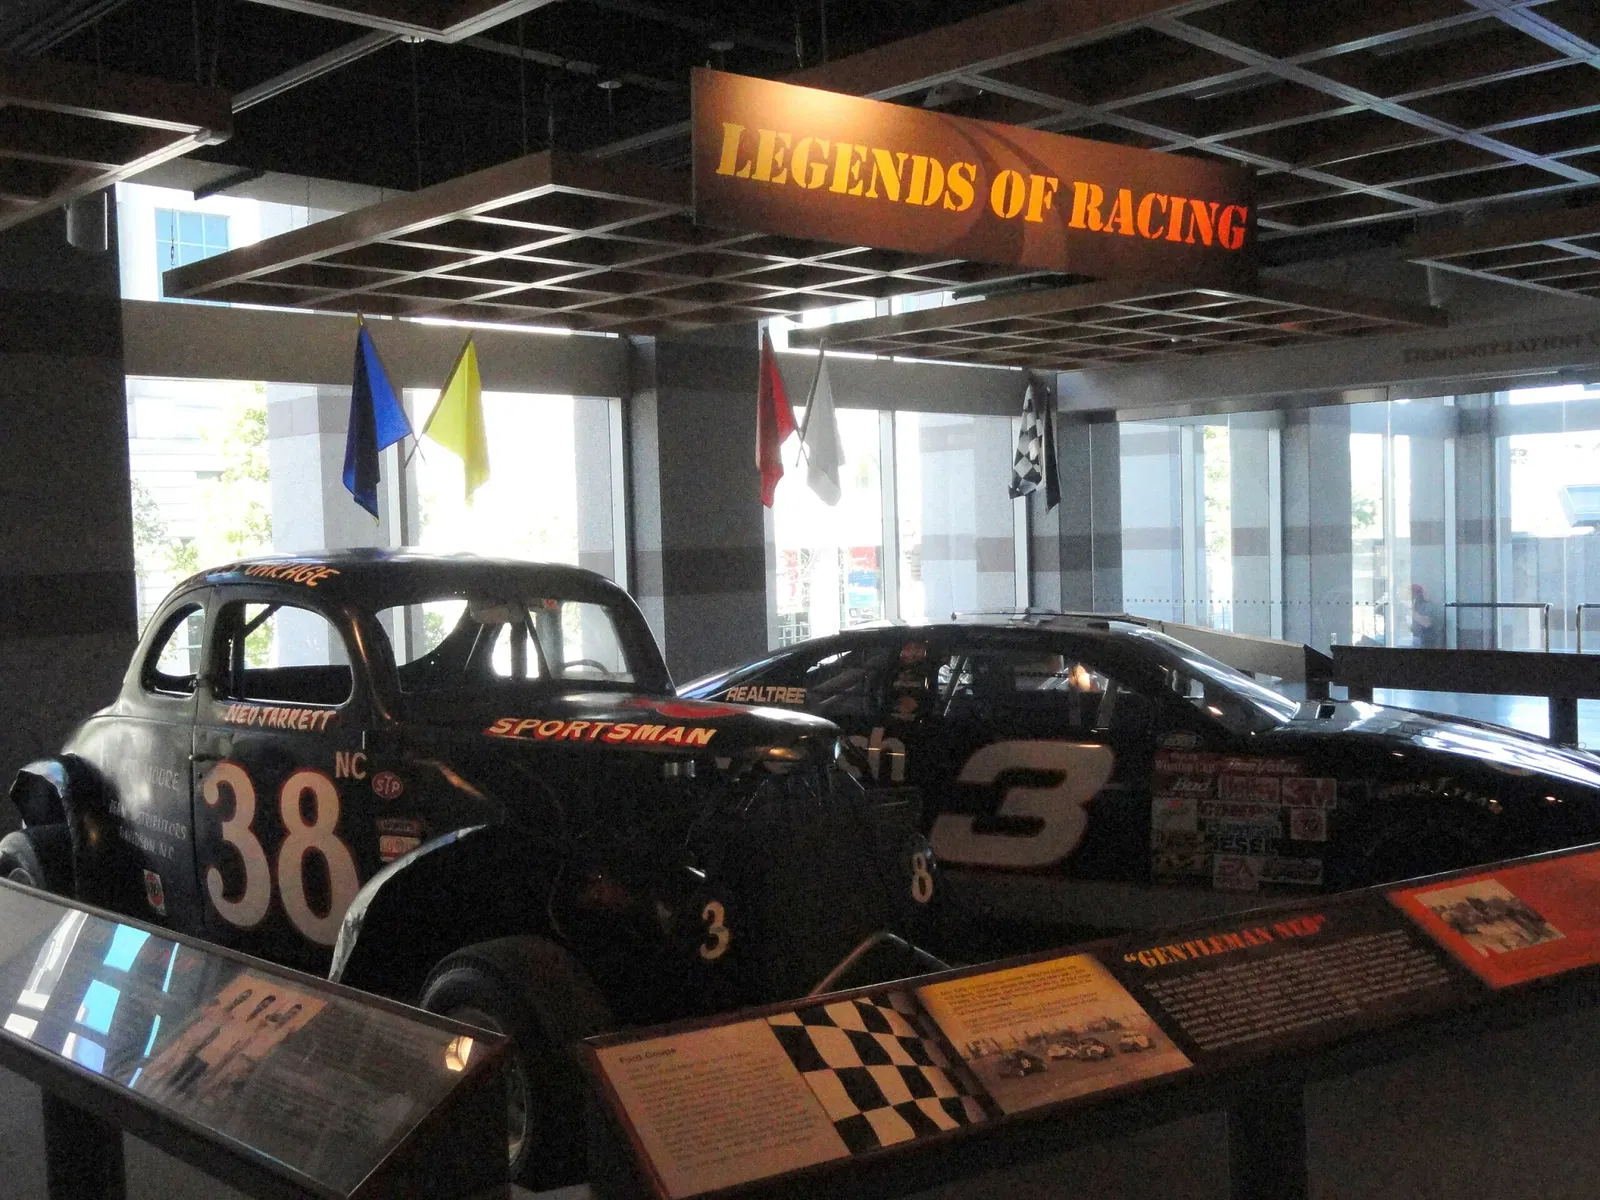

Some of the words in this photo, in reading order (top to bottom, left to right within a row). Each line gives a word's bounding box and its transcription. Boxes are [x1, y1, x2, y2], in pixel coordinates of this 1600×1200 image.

[715, 122, 978, 212] LEGENDS
[990, 170, 1058, 224] OF
[1069, 182, 1250, 251] RACING
[726, 686, 807, 704] REALTREE
[259, 707, 337, 731] JARRETT
[482, 717, 717, 748] SPORTSMAN
[336, 751, 367, 780] NC
[375, 774, 401, 796] STP
[930, 738, 1117, 867] 3
[203, 760, 361, 949] 38
[911, 851, 934, 904] 8
[700, 900, 729, 961] 3
